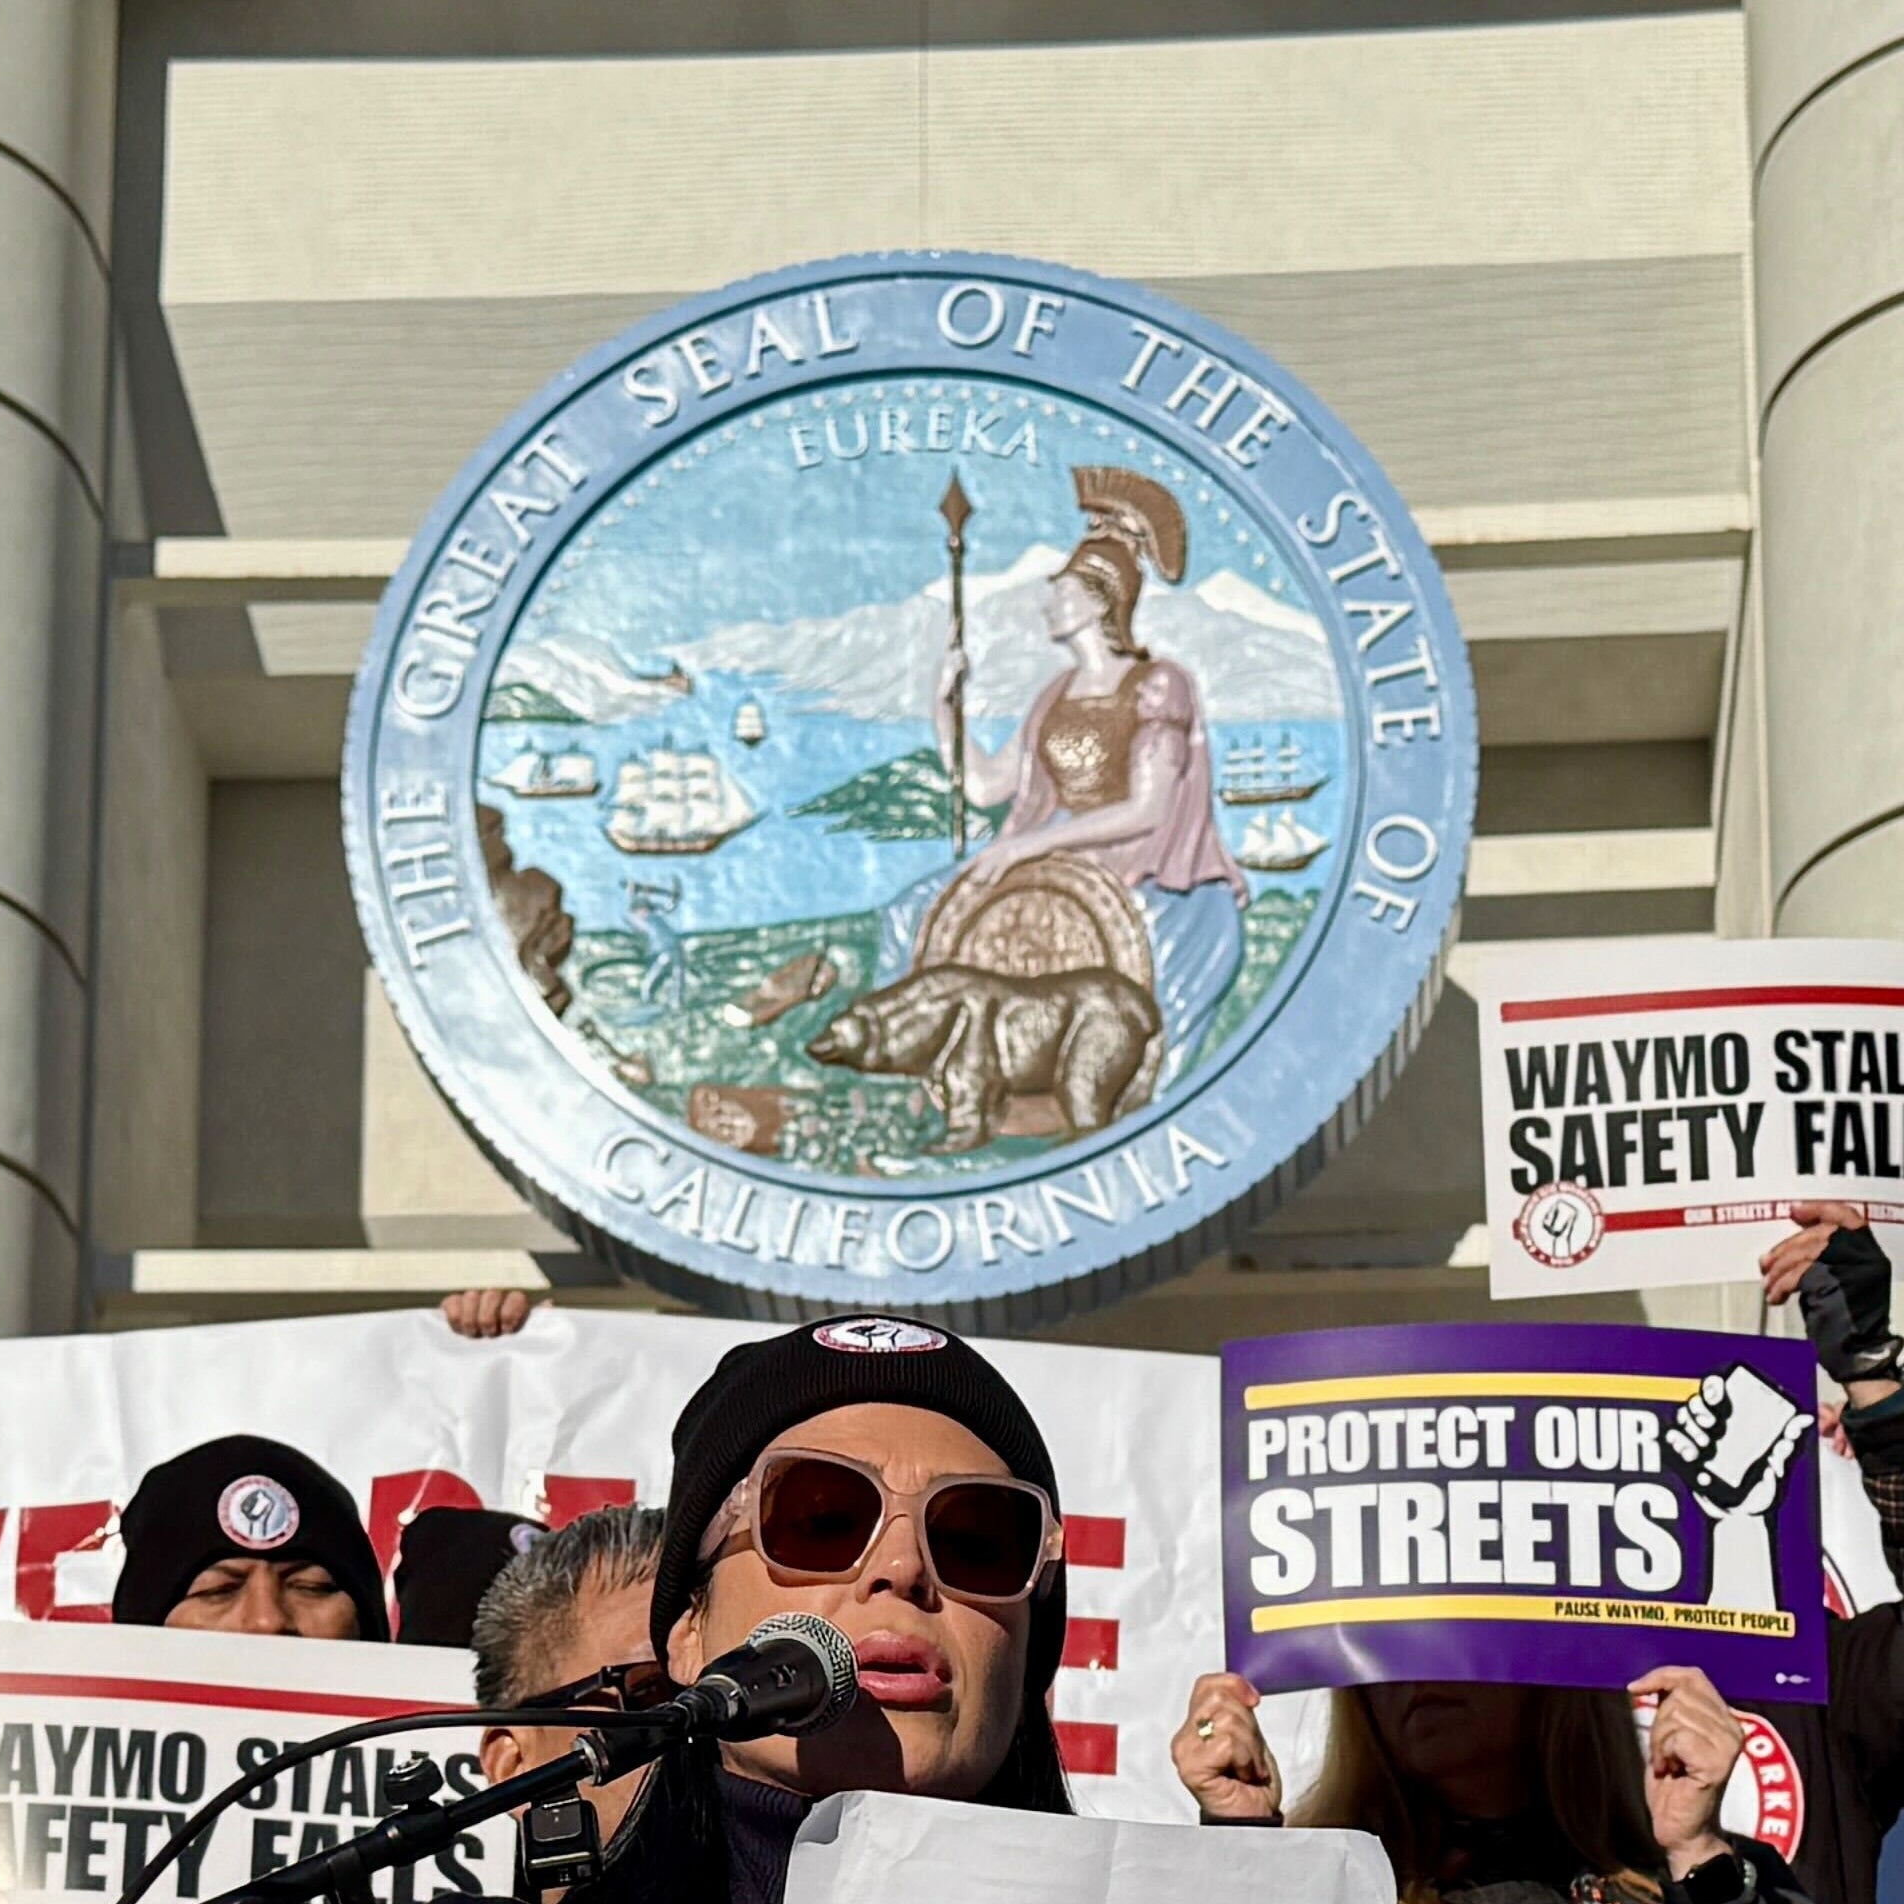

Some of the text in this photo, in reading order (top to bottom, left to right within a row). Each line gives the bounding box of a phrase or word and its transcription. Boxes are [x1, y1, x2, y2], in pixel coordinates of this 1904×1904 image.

[792, 408, 1044, 469] EUREKA
[379, 283, 1441, 969] THE GREAT SEAL OF THE STATE OF
[1504, 1032, 1750, 1110] WAYMO
[1509, 1101, 1765, 1196] SAFETY
[592, 1123, 1229, 1272] CALIFORNIA
[1248, 1405, 1660, 1480] PROTECT OUR
[1249, 1479, 1682, 1596] STREETS
[1555, 1601, 1790, 1631] PAUSE WAYMO, PROTECT PEOPLE
[1740, 1718, 1792, 1838] ORKE
